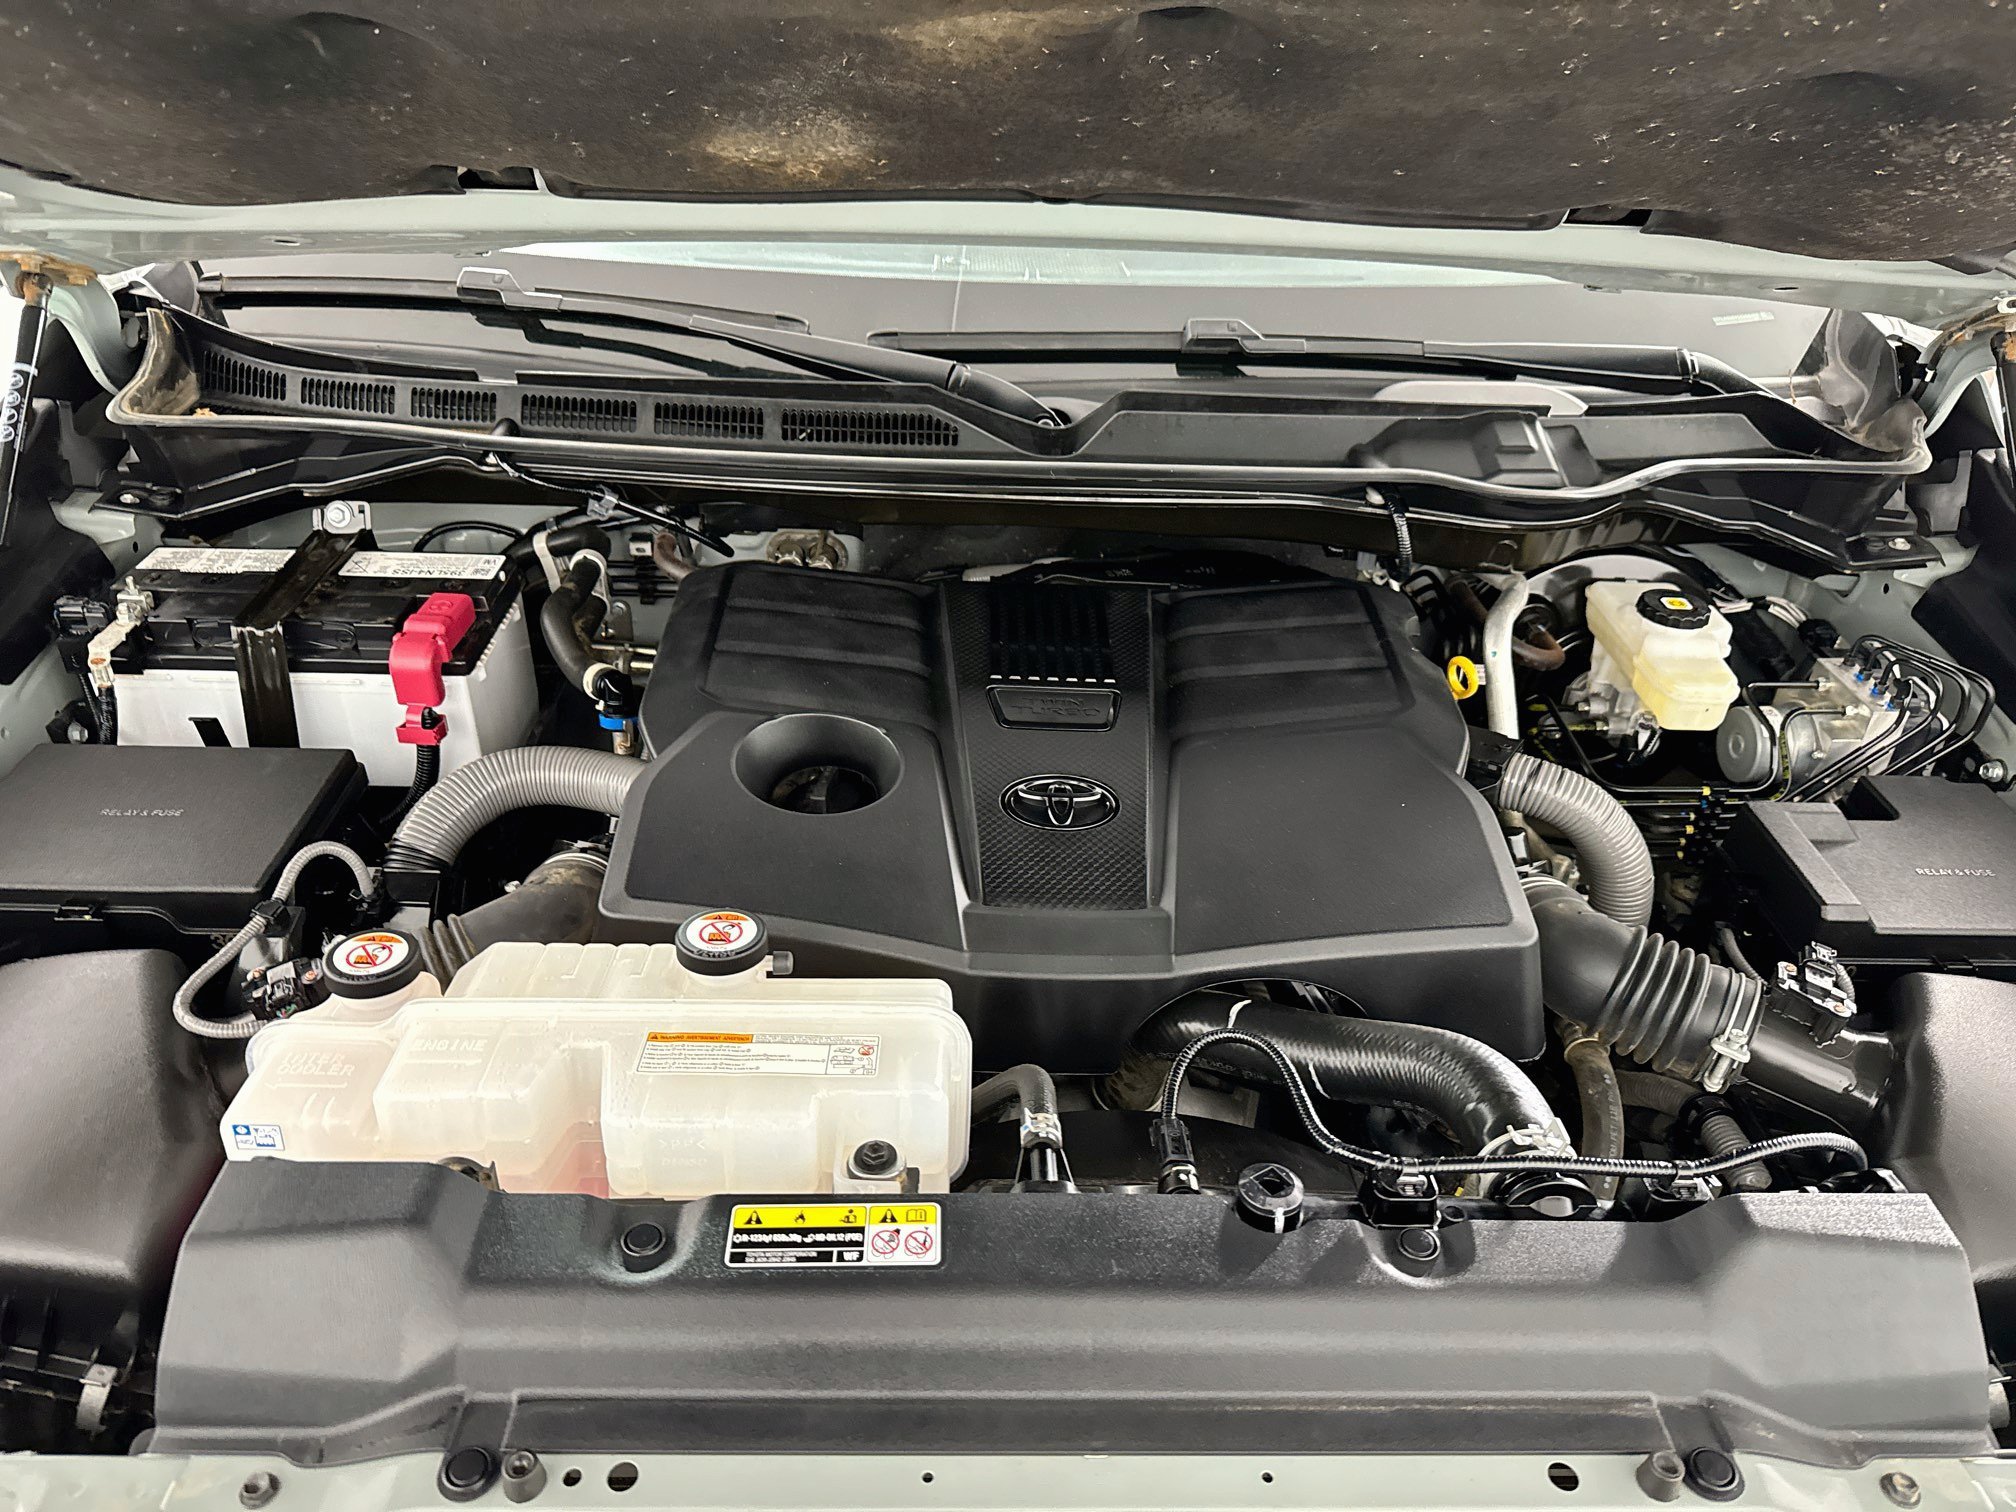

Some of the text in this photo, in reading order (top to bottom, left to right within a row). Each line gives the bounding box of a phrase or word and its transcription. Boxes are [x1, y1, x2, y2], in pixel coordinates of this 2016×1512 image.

[100, 808, 140, 817] RELAY
[150, 809, 184, 817] FUSE
[1915, 867, 1953, 876] RELAY
[1963, 868, 1997, 877] FUSE
[413, 1039, 489, 1052] ENGINE
[281, 1051, 346, 1064] INTER
[276, 1063, 356, 1077] COOLER
